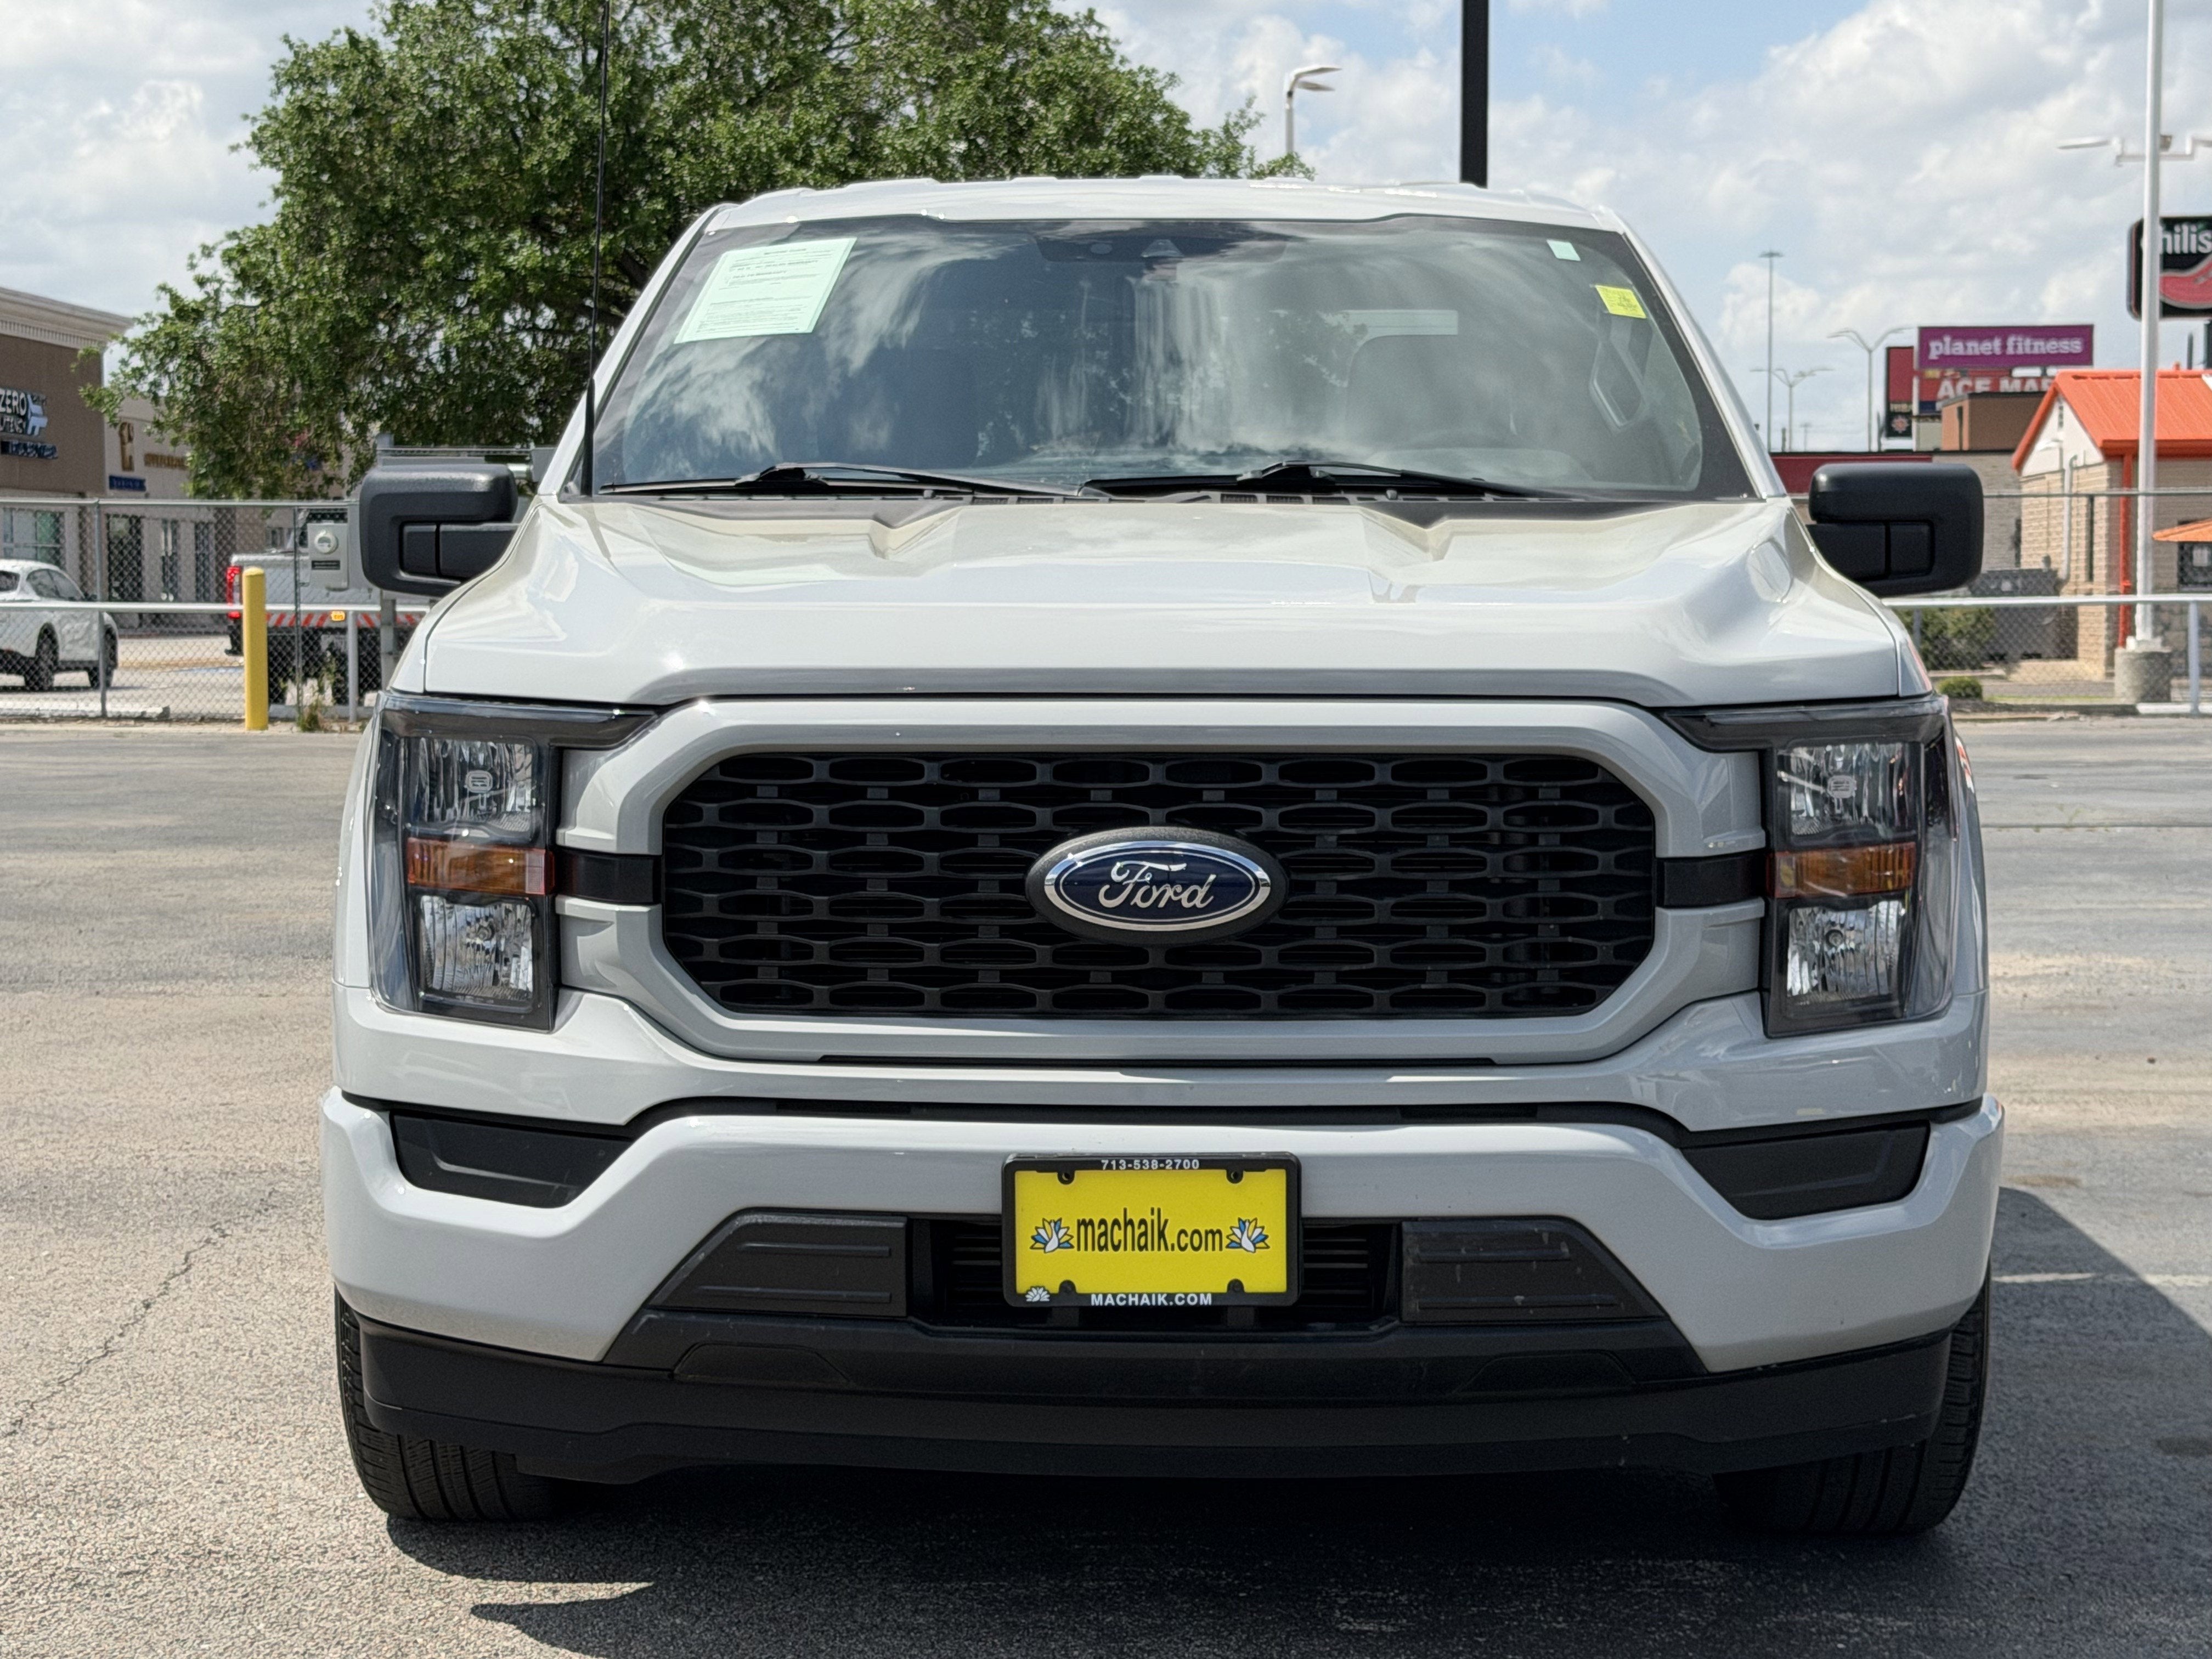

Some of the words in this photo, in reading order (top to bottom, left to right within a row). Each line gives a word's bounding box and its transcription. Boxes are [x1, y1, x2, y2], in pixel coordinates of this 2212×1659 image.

[1928, 335, 2002, 359] planet
[2006, 334, 2083, 355] fitness
[1937, 377, 1992, 399] ACE
[1098, 860, 1217, 909] Ford
[1101, 1159, 1200, 1170] 713-538-2700
[1076, 1207, 1223, 1252] machaik.com
[1090, 1293, 1212, 1306] MACHAIK.COM
